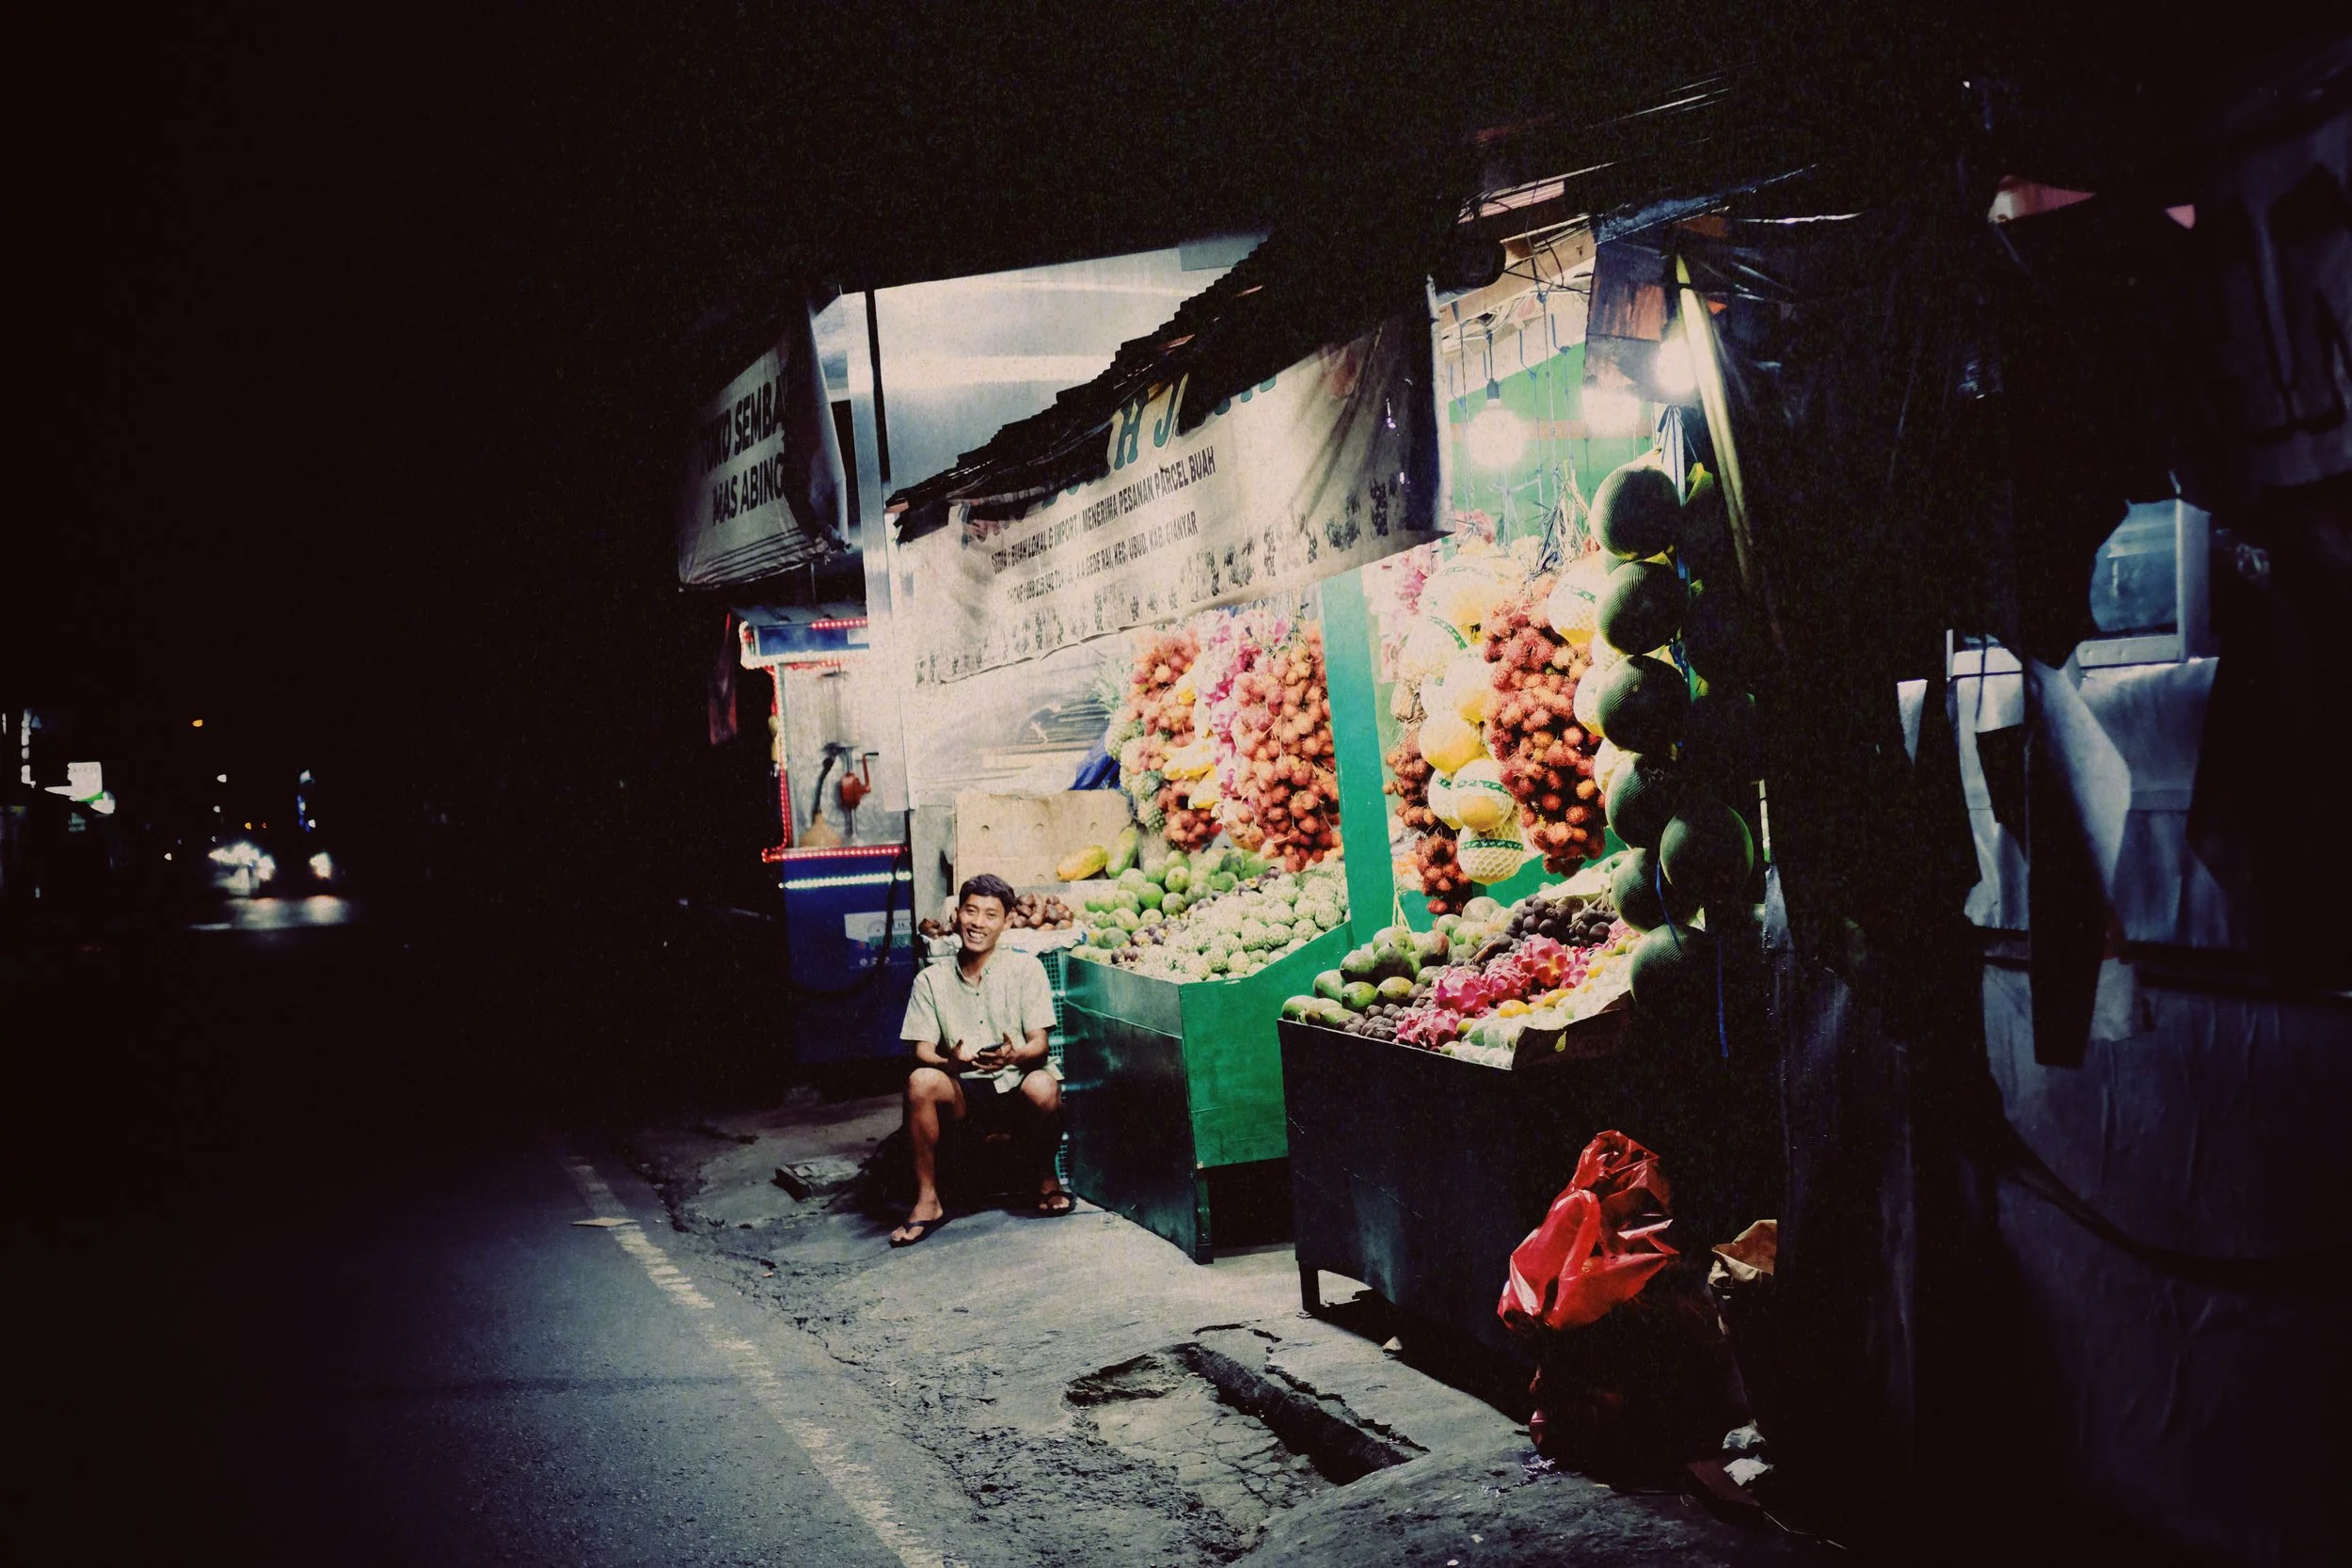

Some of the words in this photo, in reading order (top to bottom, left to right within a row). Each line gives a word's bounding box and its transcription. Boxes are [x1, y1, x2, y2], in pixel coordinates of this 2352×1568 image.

[712, 475, 738, 526] MAS
[1027, 530, 1047, 560] LOKAL
[1054, 514, 1077, 546] IMPORT
[1082, 493, 1119, 533] MENERIMA
[1119, 475, 1155, 515] PESANAN
[1154, 460, 1188, 499] PARCEL
[1188, 446, 1216, 483] BUAH
[1166, 510, 1199, 545] GIANYAR
